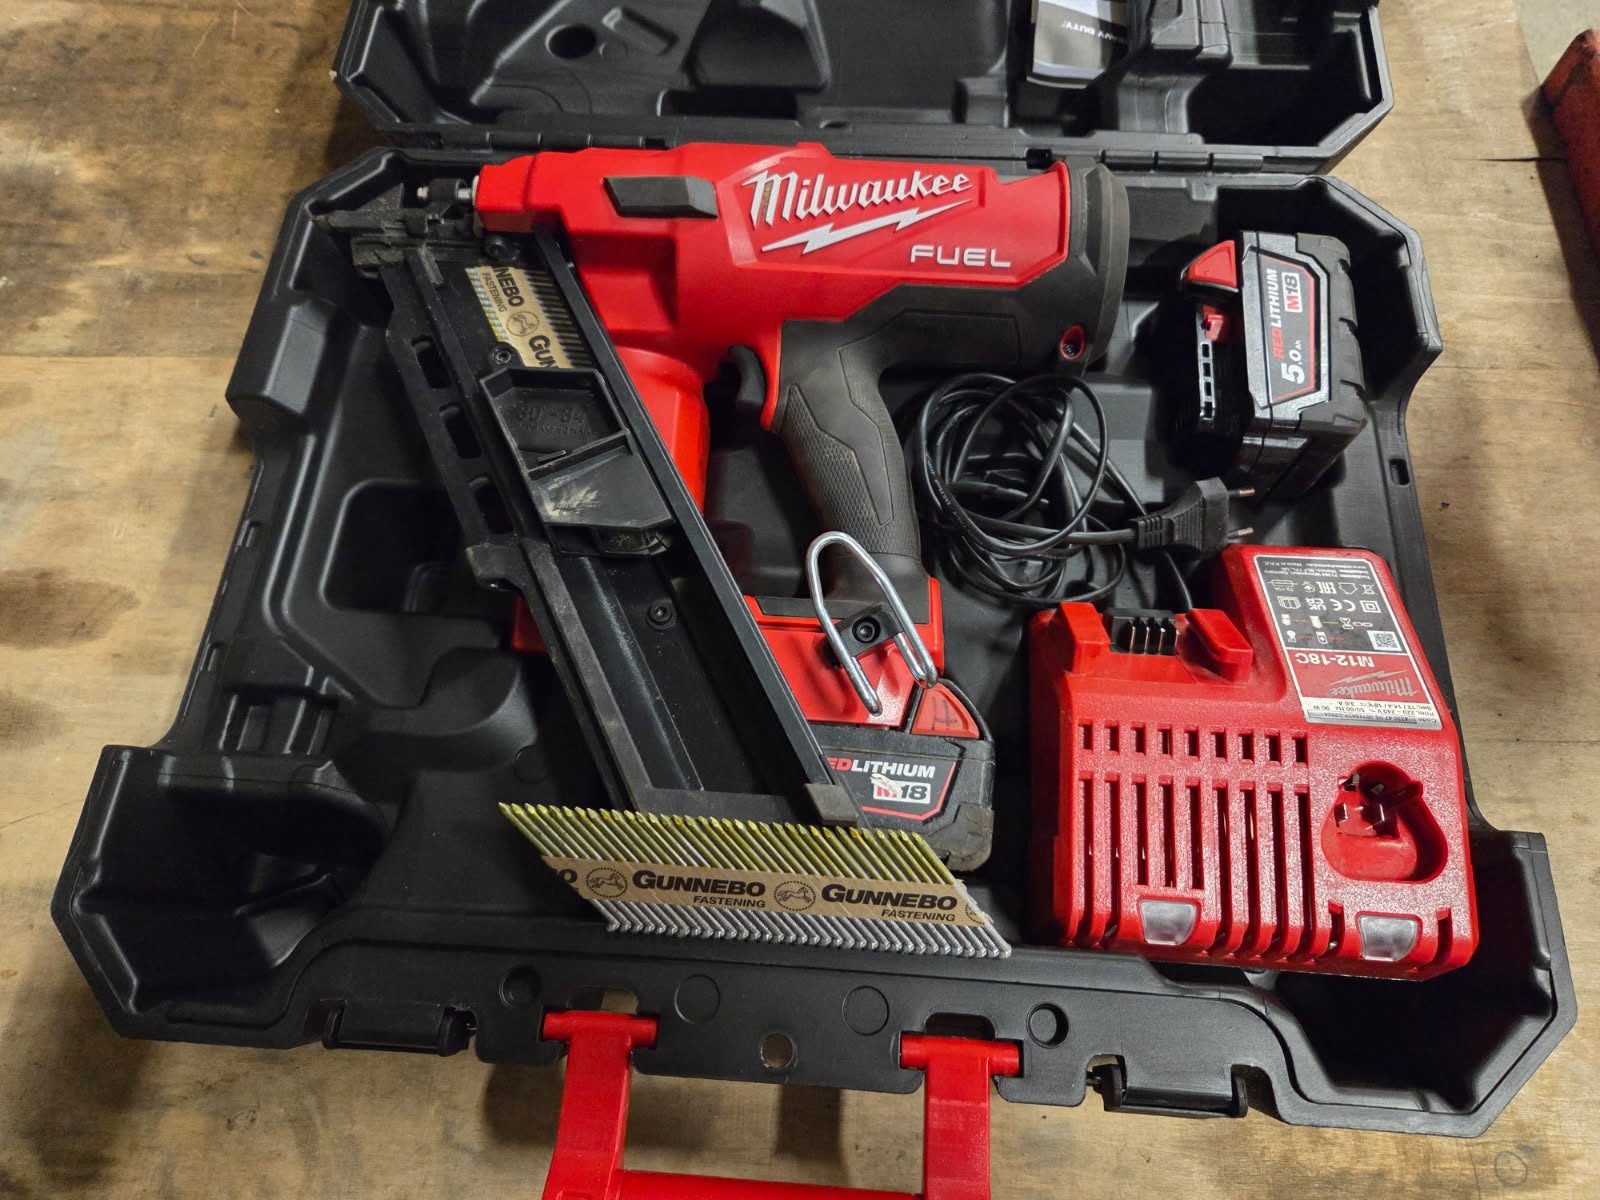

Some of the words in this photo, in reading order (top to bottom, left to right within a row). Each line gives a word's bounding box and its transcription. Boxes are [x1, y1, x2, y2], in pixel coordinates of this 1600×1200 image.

[742, 170, 973, 229] Milwaukee
[910, 244, 1011, 268] FUEL
[481, 272, 507, 313] FASTENING
[1285, 274, 1302, 311] M18
[1266, 269, 1284, 360] REDLITHIUM
[1295, 652, 1375, 668] M12-18C
[1329, 677, 1420, 698] Milwaukee
[826, 757, 936, 779] EDLITHIUM
[632, 869, 766, 897] GUNNEBO
[821, 883, 958, 911] GUNNEBO
[693, 895, 766, 909] FASTENING
[881, 908, 956, 922] FASTENING
